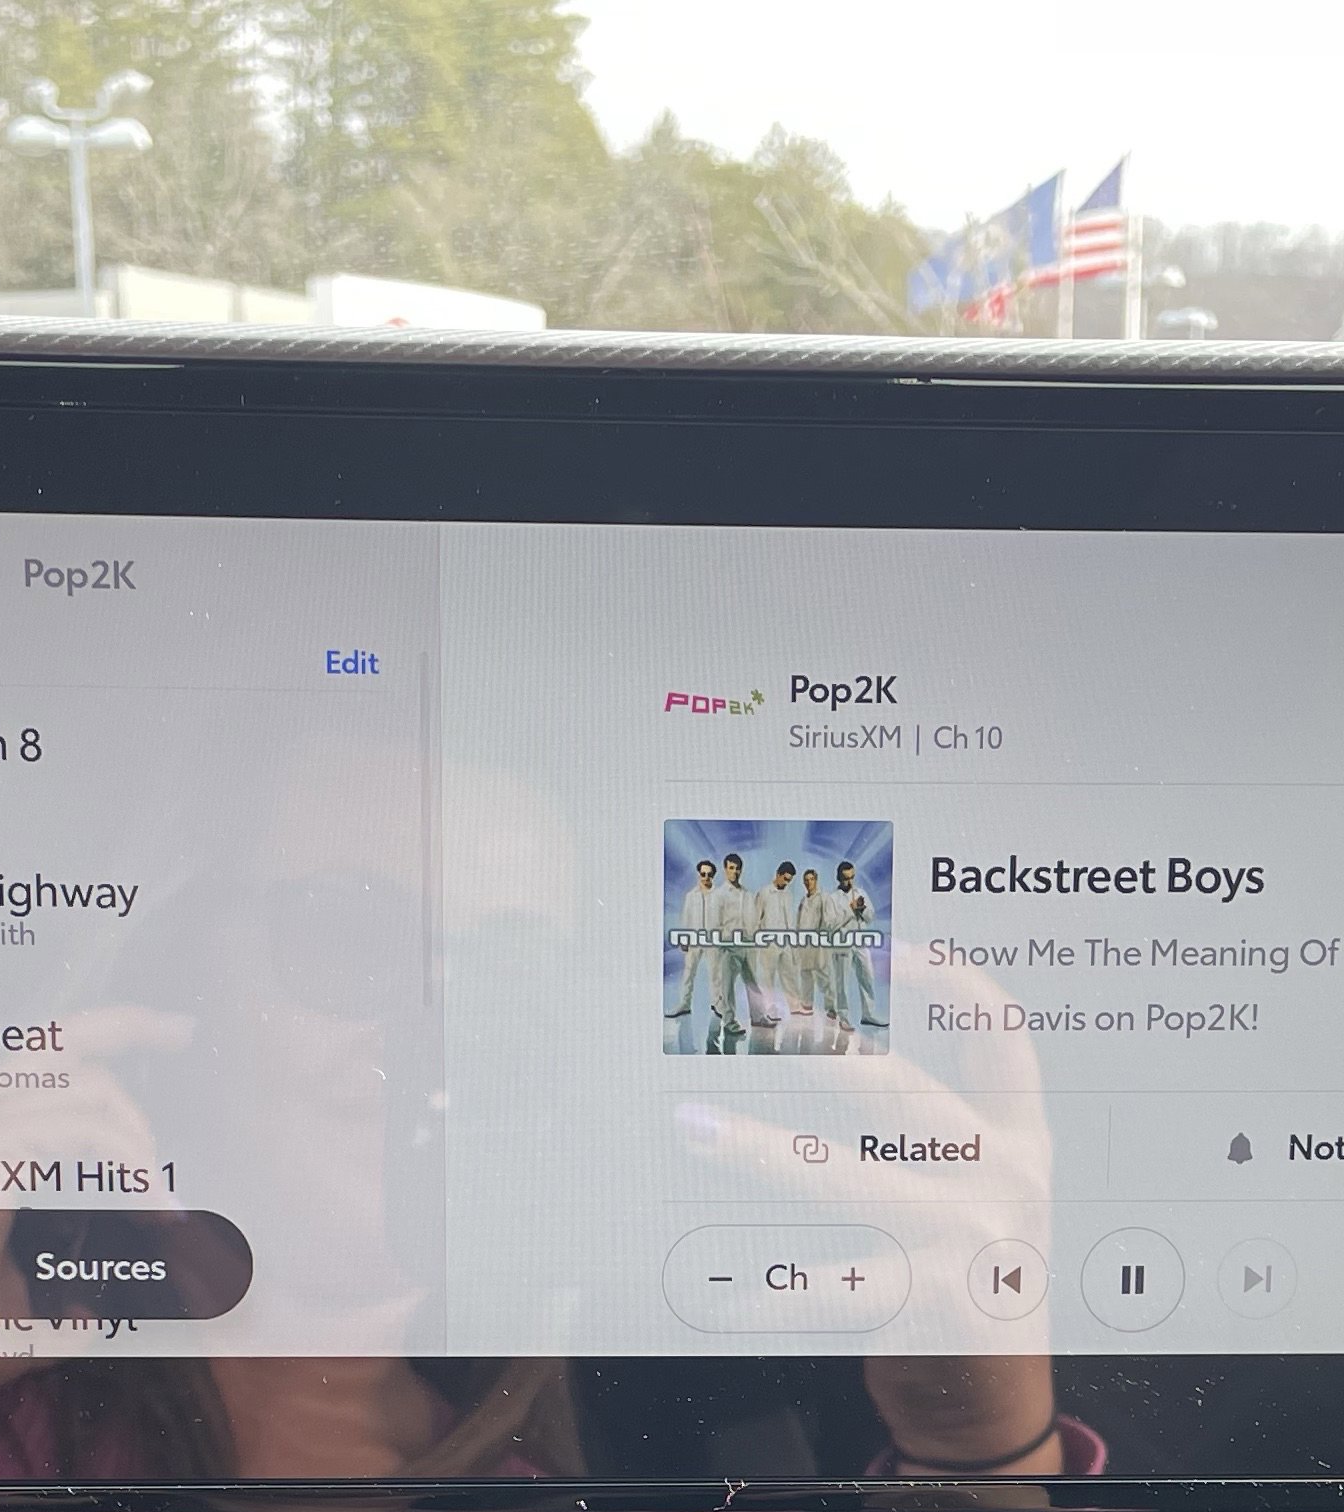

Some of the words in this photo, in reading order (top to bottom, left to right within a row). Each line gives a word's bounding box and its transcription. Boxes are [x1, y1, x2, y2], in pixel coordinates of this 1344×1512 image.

[24, 557, 137, 597] Pop2K
[326, 649, 380, 676] Edit
[792, 674, 898, 711] Pop2K
[19, 728, 43, 763] 8
[789, 723, 901, 749] SiriusXM
[934, 724, 968, 749] Ch
[974, 727, 1003, 750] 10
[931, 856, 1156, 895] Backstreet
[1167, 857, 1266, 902] Boys
[927, 939, 1022, 968] Show
[1029, 940, 1076, 968] Me
[1084, 940, 1143, 968] The
[1151, 939, 1290, 975] Meaning
[1299, 938, 1340, 968] Of
[927, 1003, 993, 1033] Rich
[1003, 1003, 1087, 1033] Davis
[1095, 1010, 1136, 1033] on
[1146, 1003, 1260, 1041] Pop2K!
[860, 1135, 982, 1164] Related
[77, 1160, 151, 1194] Hits
[163, 1161, 178, 1193] 1
[36, 1252, 167, 1281] Sources
[766, 1264, 808, 1291] Ch
